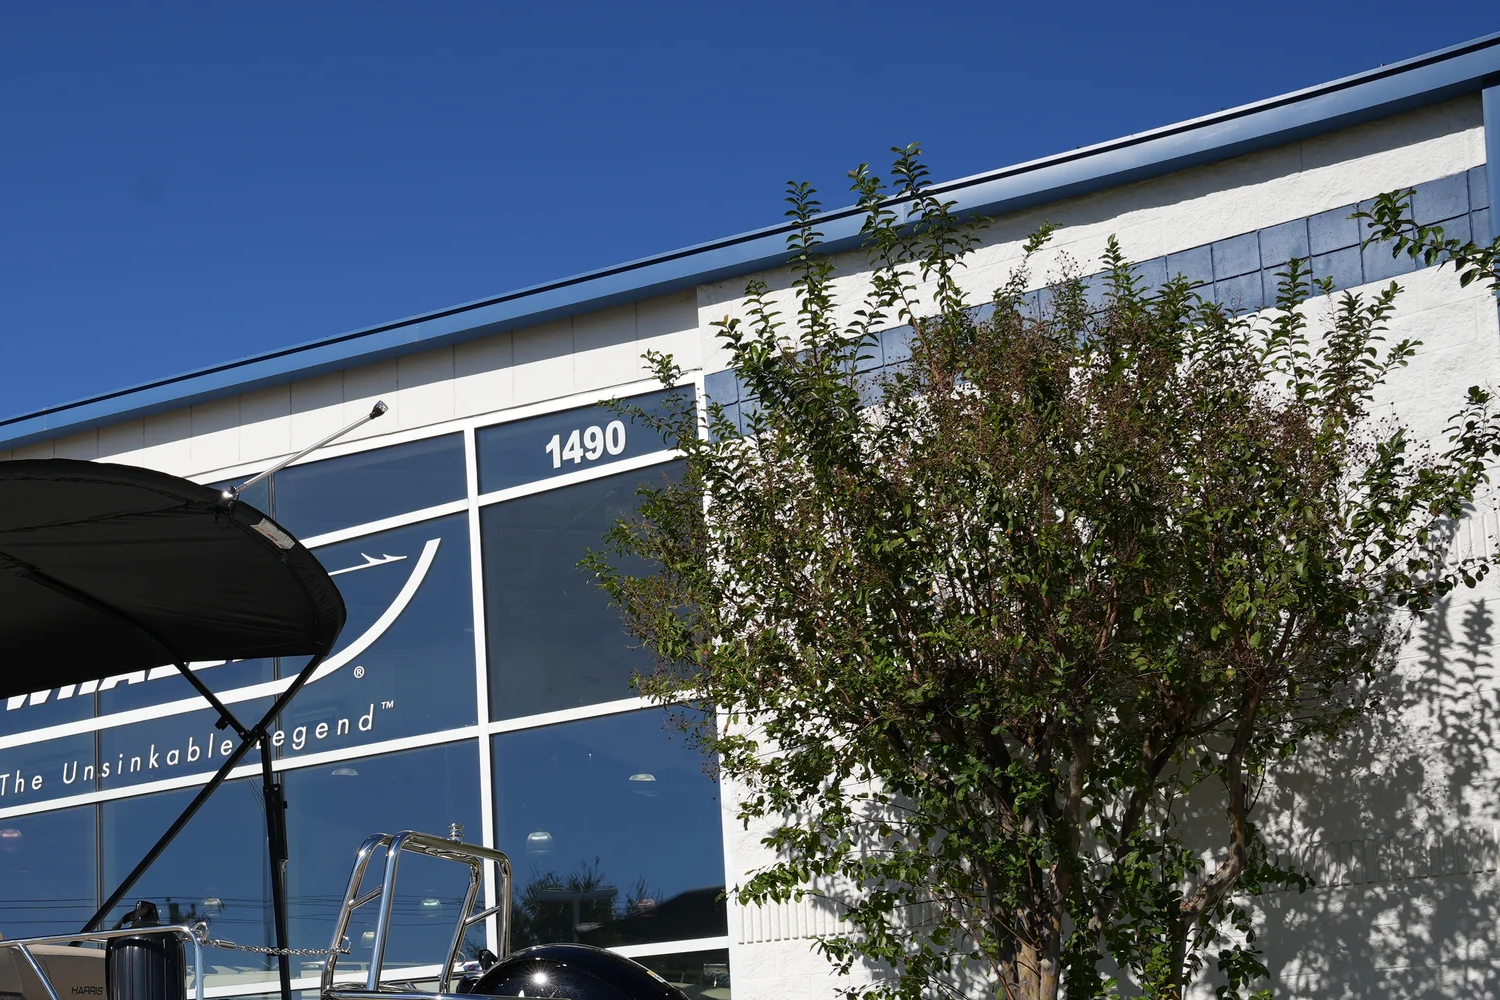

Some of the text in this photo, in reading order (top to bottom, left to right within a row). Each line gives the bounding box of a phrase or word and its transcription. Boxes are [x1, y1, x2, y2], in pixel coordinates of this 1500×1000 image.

[545, 420, 627, 469] 1490
[0, 770, 43, 796] The
[62, 733, 234, 785] Unsinkable
[71, 985, 104, 996] HARRIS
